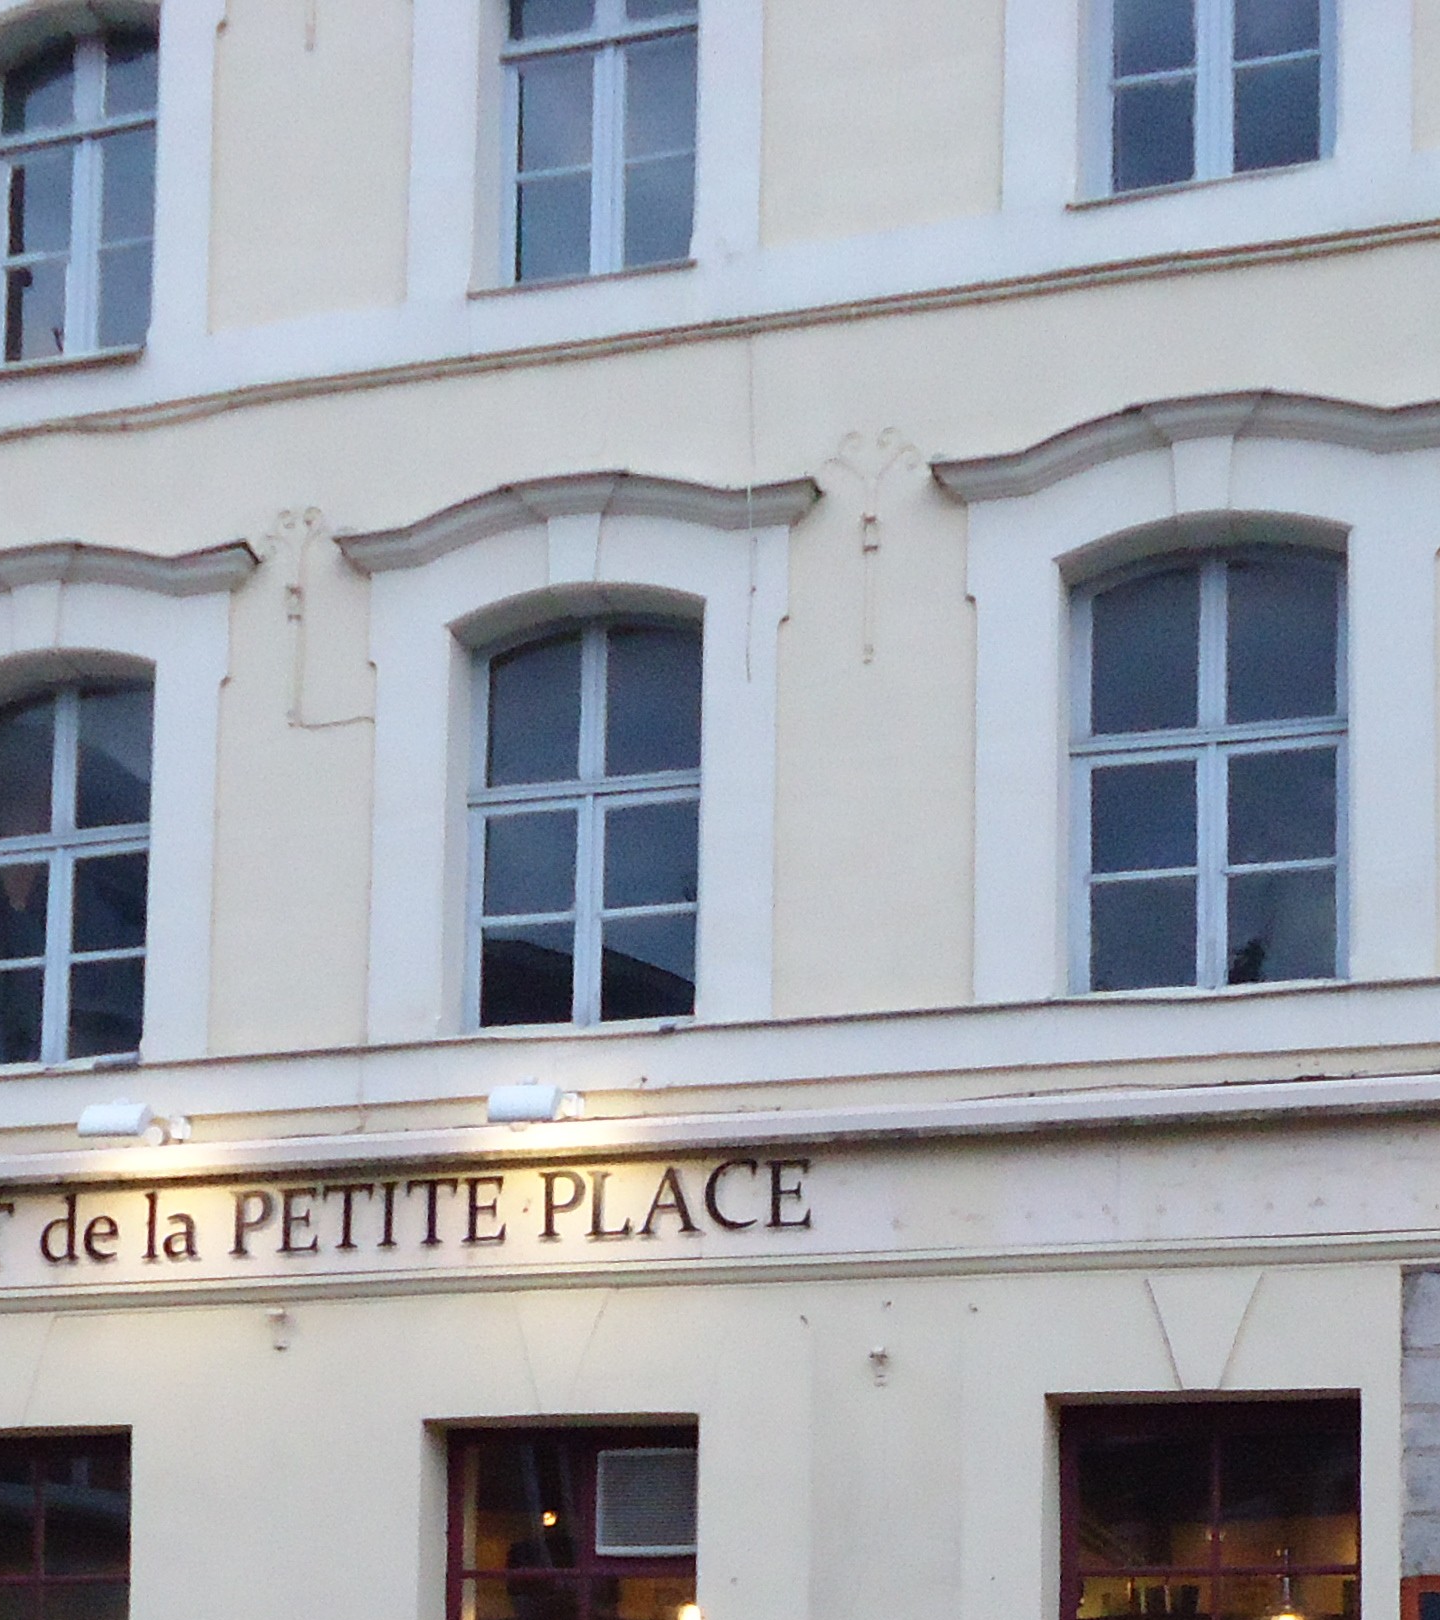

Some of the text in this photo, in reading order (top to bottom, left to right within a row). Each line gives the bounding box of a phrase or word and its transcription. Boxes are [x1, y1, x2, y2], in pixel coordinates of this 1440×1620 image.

[39, 1194, 120, 1266] de
[140, 1192, 198, 1263] la
[228, 1175, 507, 1256] PETITE
[538, 1158, 812, 1240] PLACE
